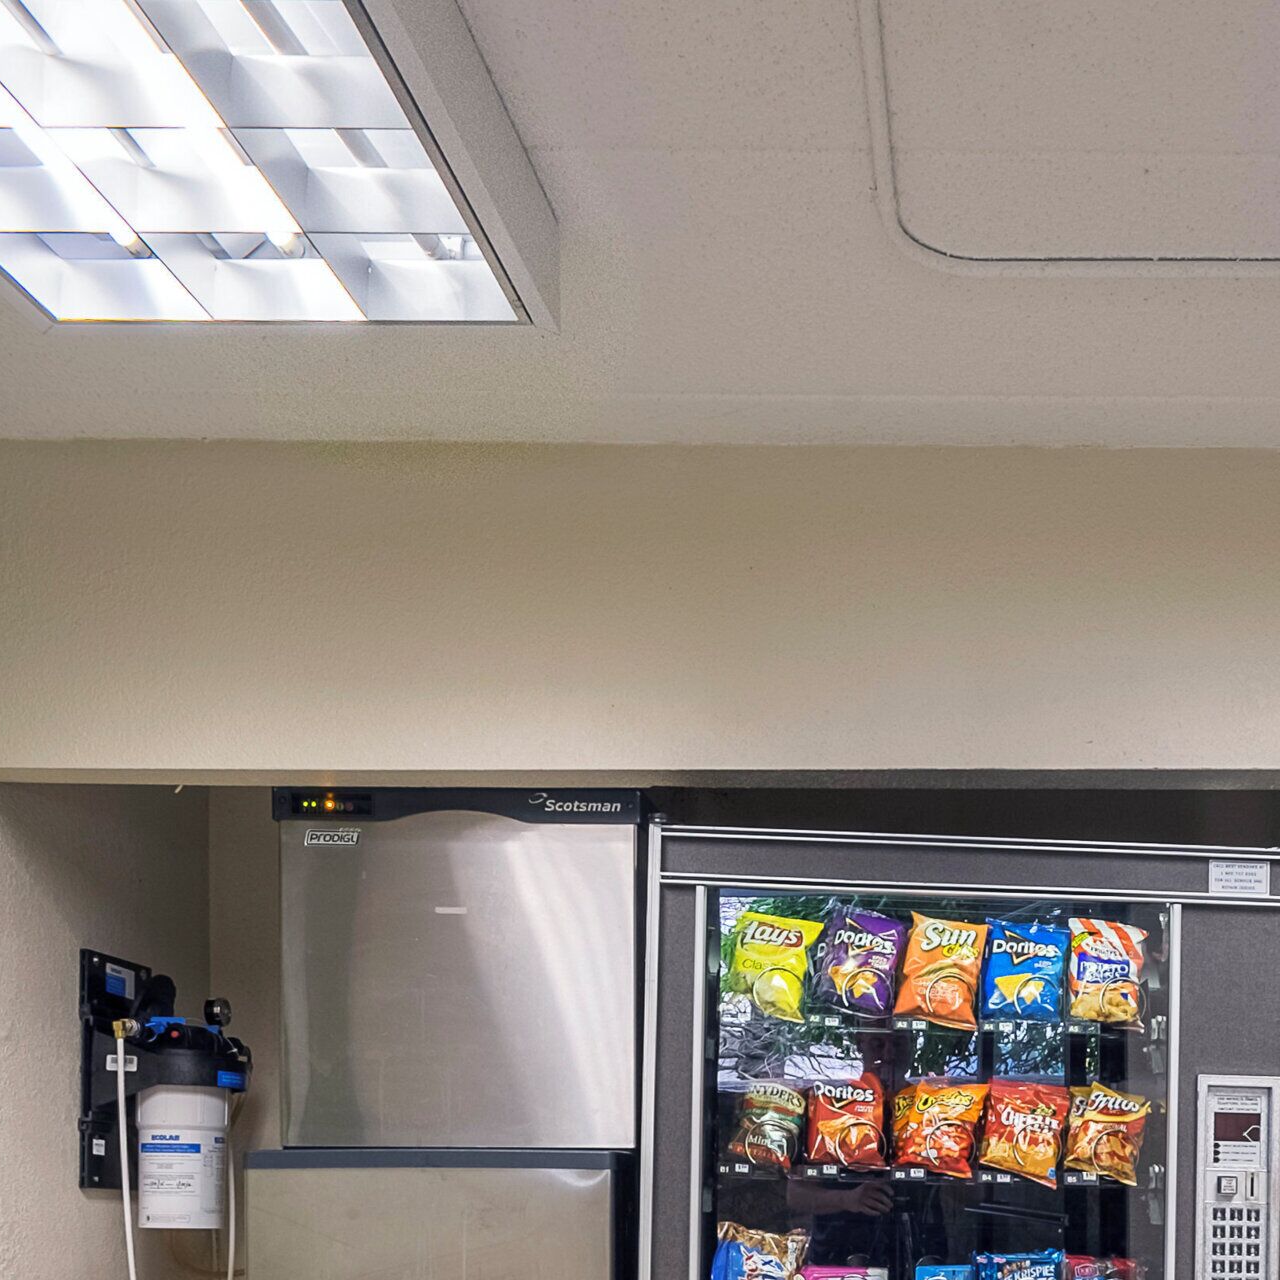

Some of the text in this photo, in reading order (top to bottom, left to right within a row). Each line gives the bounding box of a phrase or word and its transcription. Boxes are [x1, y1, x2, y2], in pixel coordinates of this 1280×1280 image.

[544, 799, 621, 812] Scotsman
[921, 921, 978, 951] Sun
[992, 938, 1058, 957] Doritos
[813, 1080, 875, 1102] Doritos
[1087, 1090, 1140, 1113] Fritos
